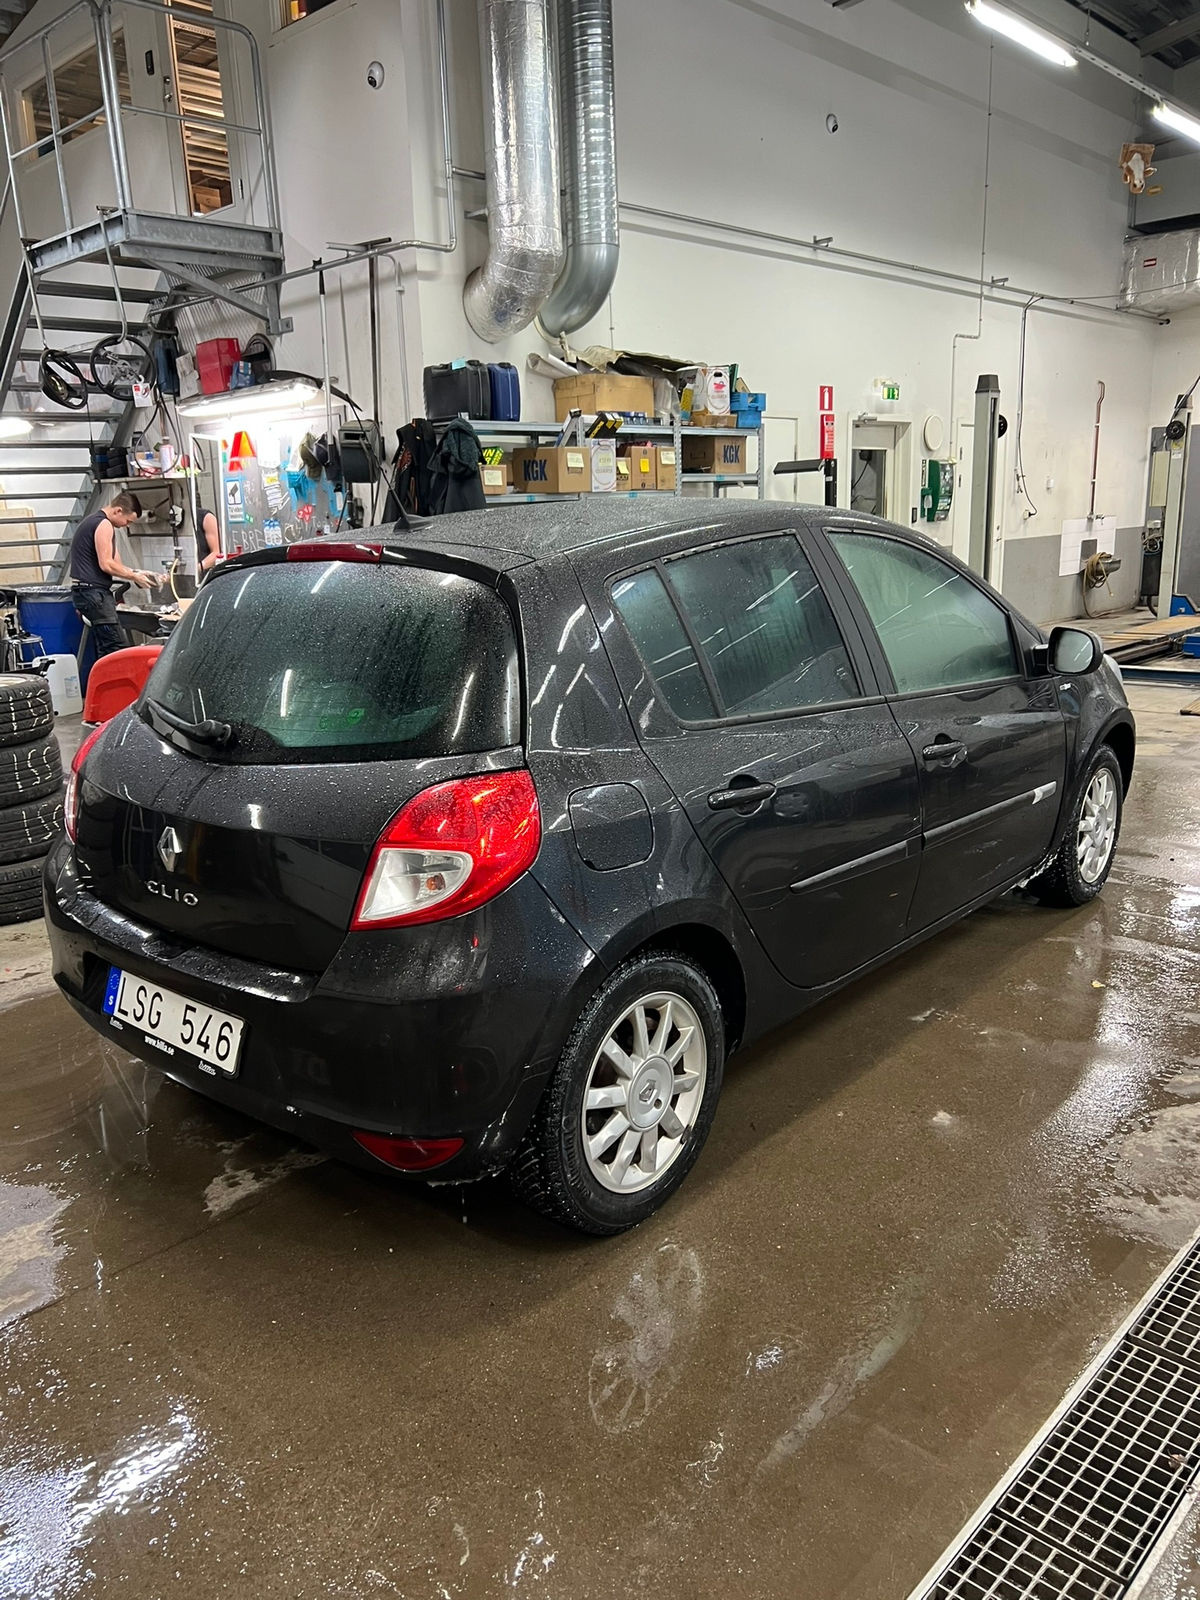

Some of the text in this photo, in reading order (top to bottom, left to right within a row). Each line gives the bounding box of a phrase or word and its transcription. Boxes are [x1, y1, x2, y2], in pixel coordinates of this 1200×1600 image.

[723, 444, 740, 464] KGK
[523, 459, 548, 481] KGK
[146, 880, 199, 906] CLIO
[108, 995, 114, 1006] S
[117, 977, 234, 1061] LSG 546
